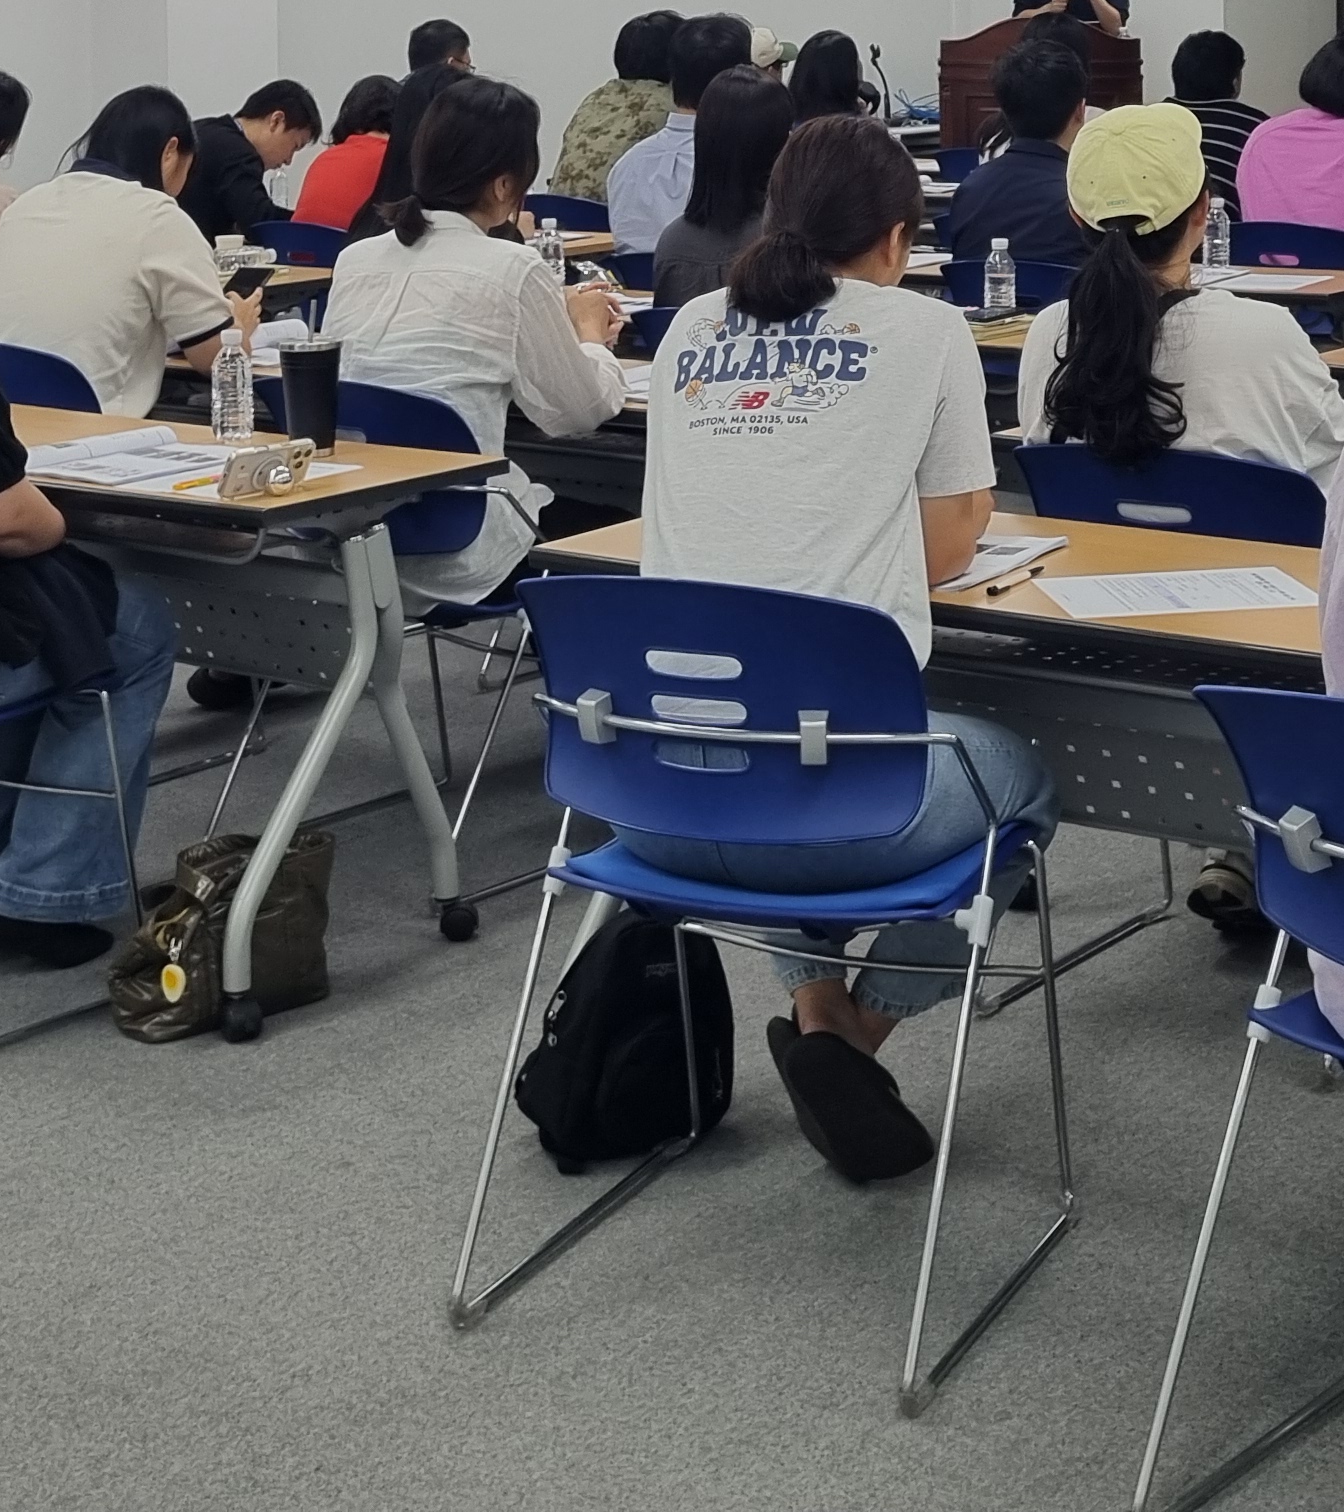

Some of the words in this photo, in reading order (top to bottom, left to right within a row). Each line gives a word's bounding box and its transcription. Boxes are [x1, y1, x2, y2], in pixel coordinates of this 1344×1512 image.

[689, 416, 727, 429] BOSTON,
[730, 416, 747, 424] MA
[749, 415, 784, 425] 02135,
[787, 415, 809, 424] USA
[712, 426, 742, 436] SINCE
[748, 425, 774, 434] 1906
